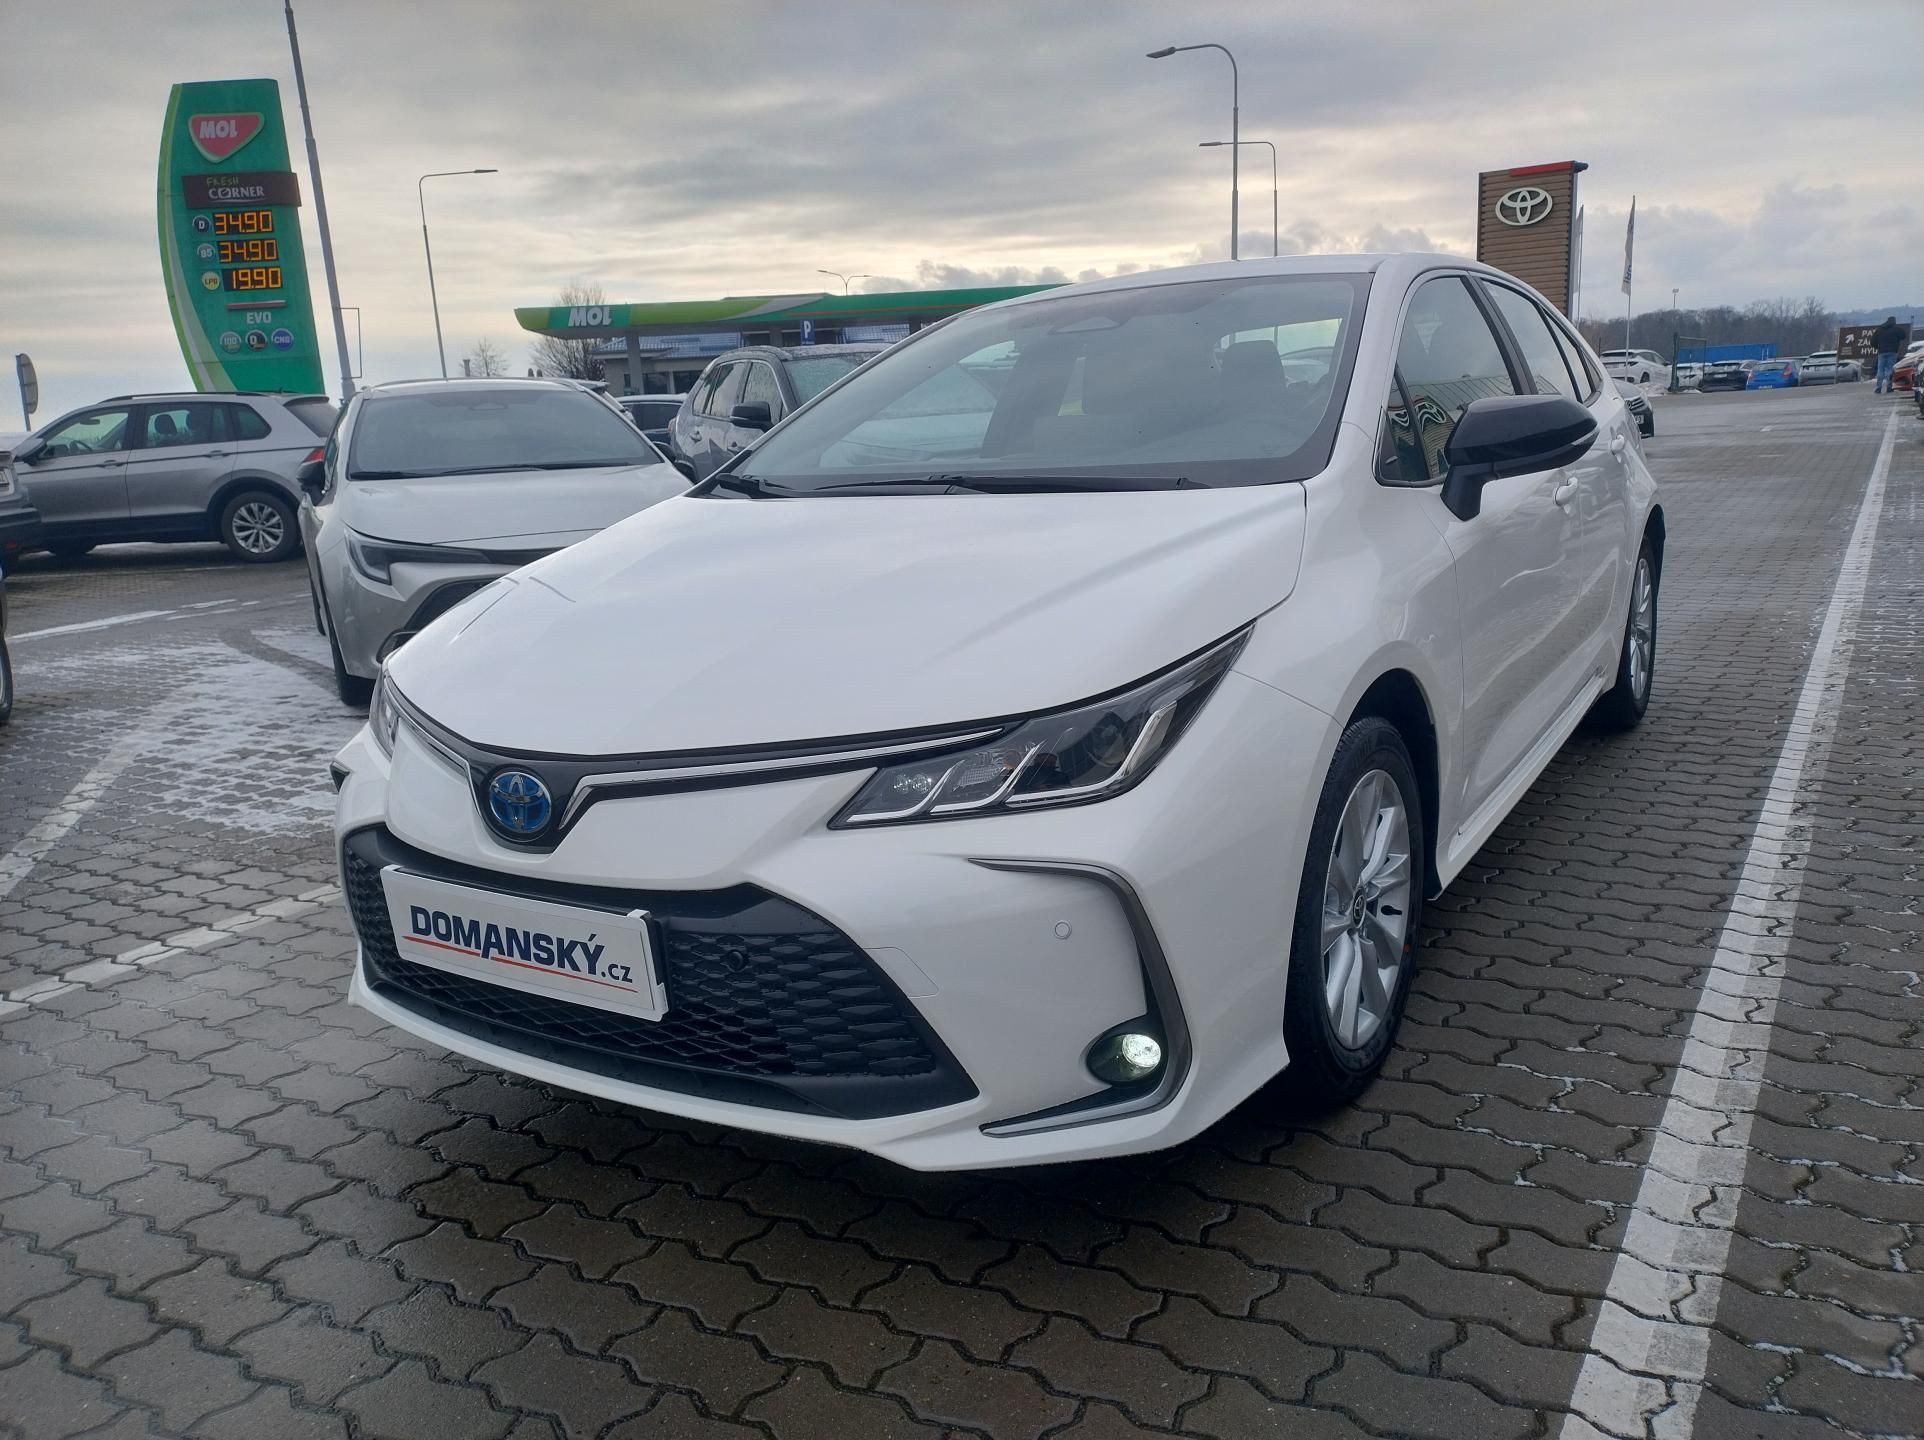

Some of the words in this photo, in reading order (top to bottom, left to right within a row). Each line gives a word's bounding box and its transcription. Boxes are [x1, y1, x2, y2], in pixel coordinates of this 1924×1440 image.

[200, 119, 238, 139] MOL
[208, 186, 265, 199] CORNER
[198, 220, 206, 229] D
[200, 248, 213, 258] 95
[246, 311, 272, 325] EVO
[568, 306, 613, 327] MOL
